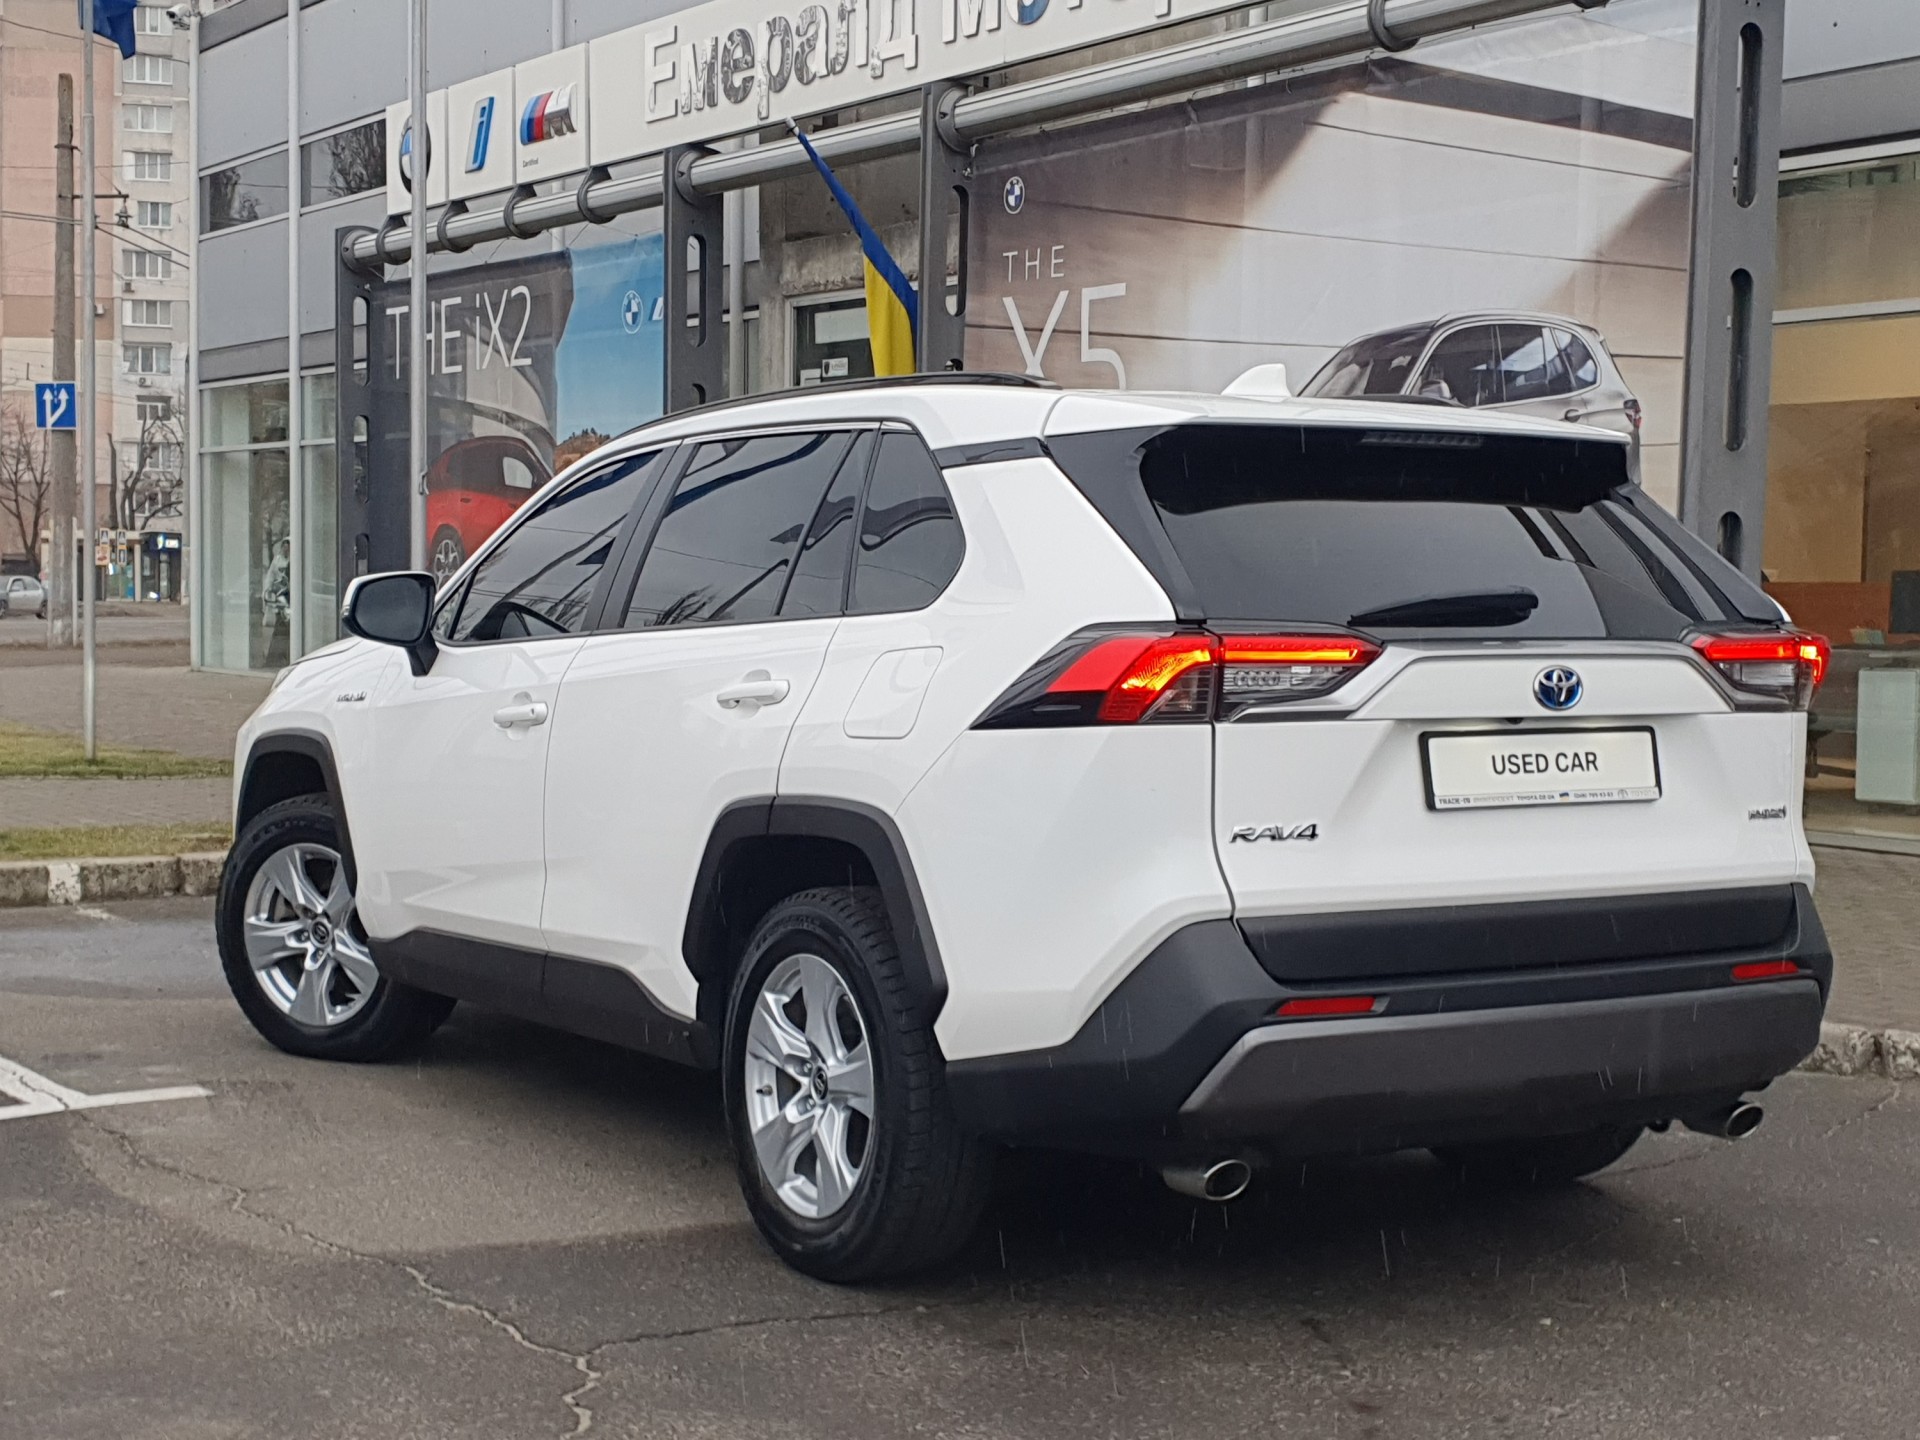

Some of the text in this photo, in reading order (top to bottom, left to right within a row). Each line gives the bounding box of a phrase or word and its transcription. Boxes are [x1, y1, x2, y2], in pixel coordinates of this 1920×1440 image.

[1002, 245, 1065, 283] THE
[475, 285, 532, 370] iX2
[1002, 282, 1127, 390] X5
[1491, 751, 1599, 775] USED CAR
[1228, 823, 1319, 844] RAV4
